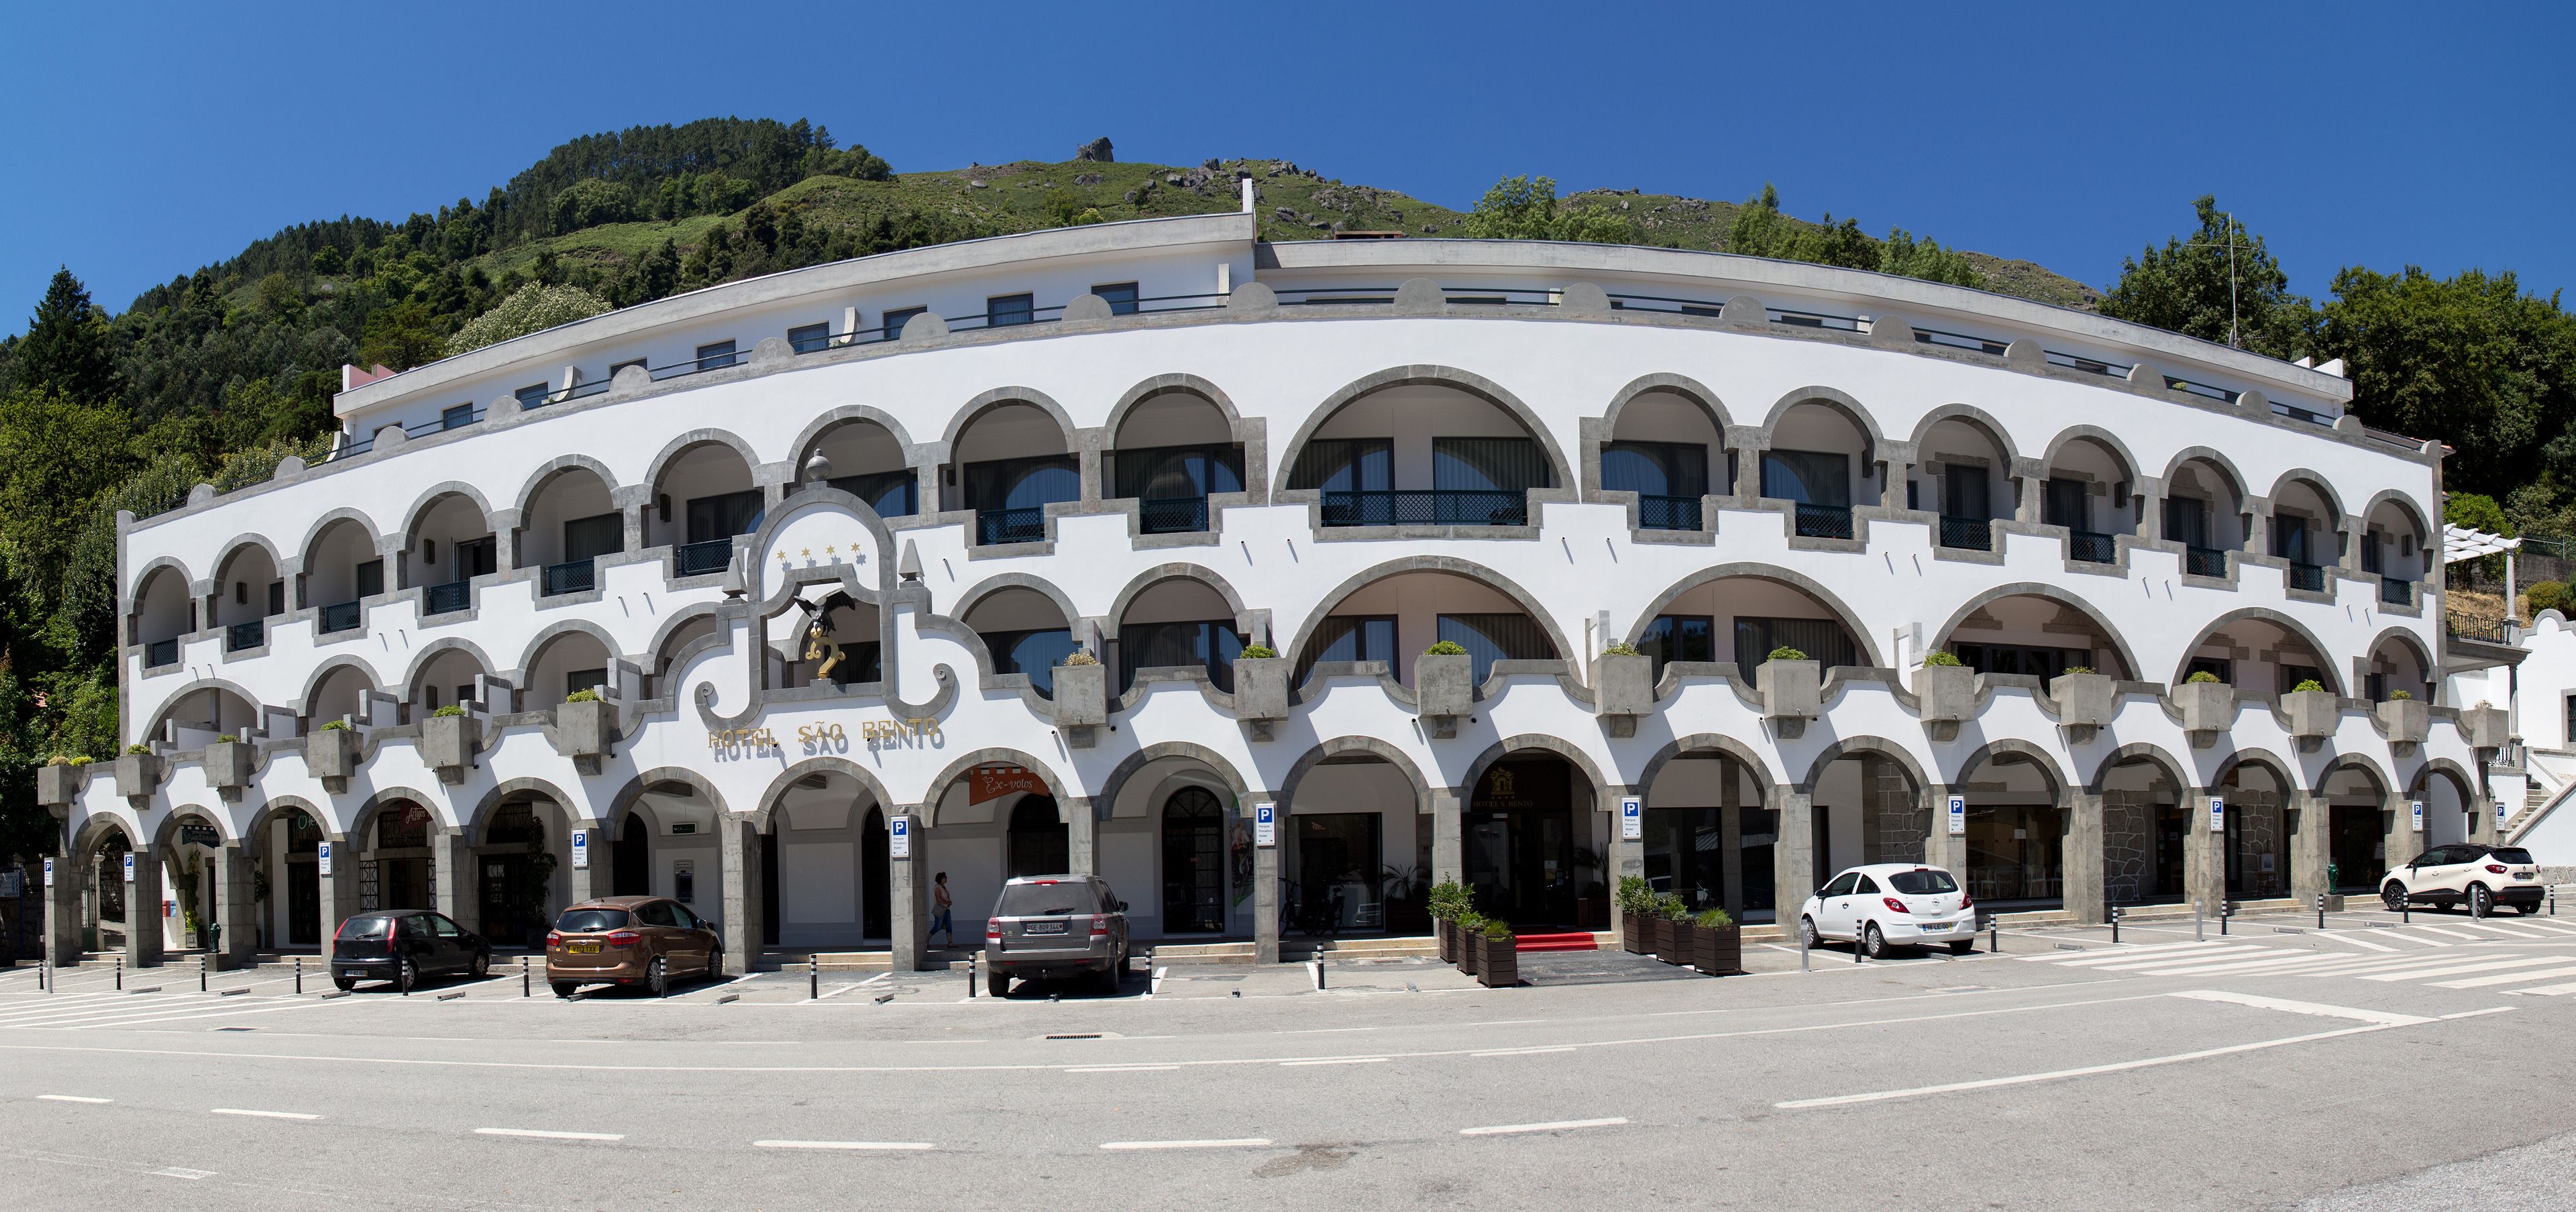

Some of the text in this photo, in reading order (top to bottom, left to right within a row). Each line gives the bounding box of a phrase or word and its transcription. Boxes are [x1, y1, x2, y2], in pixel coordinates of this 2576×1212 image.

[708, 718, 939, 749] HOTEL SÃO BENTO
[982, 776, 1033, 795] Ex-votos
[1508, 800, 1534, 808] BENTO
[1626, 803, 1636, 814] P
[1953, 801, 1960, 812] P
[2214, 802, 2220, 811] P
[2415, 805, 2420, 814] P
[2498, 808, 2503, 816] P
[1261, 809, 1270, 820] P
[896, 822, 904, 833] P
[576, 834, 584, 844] P
[322, 847, 328, 856] P
[127, 857, 131, 865] P
[46, 863, 51, 871] P
